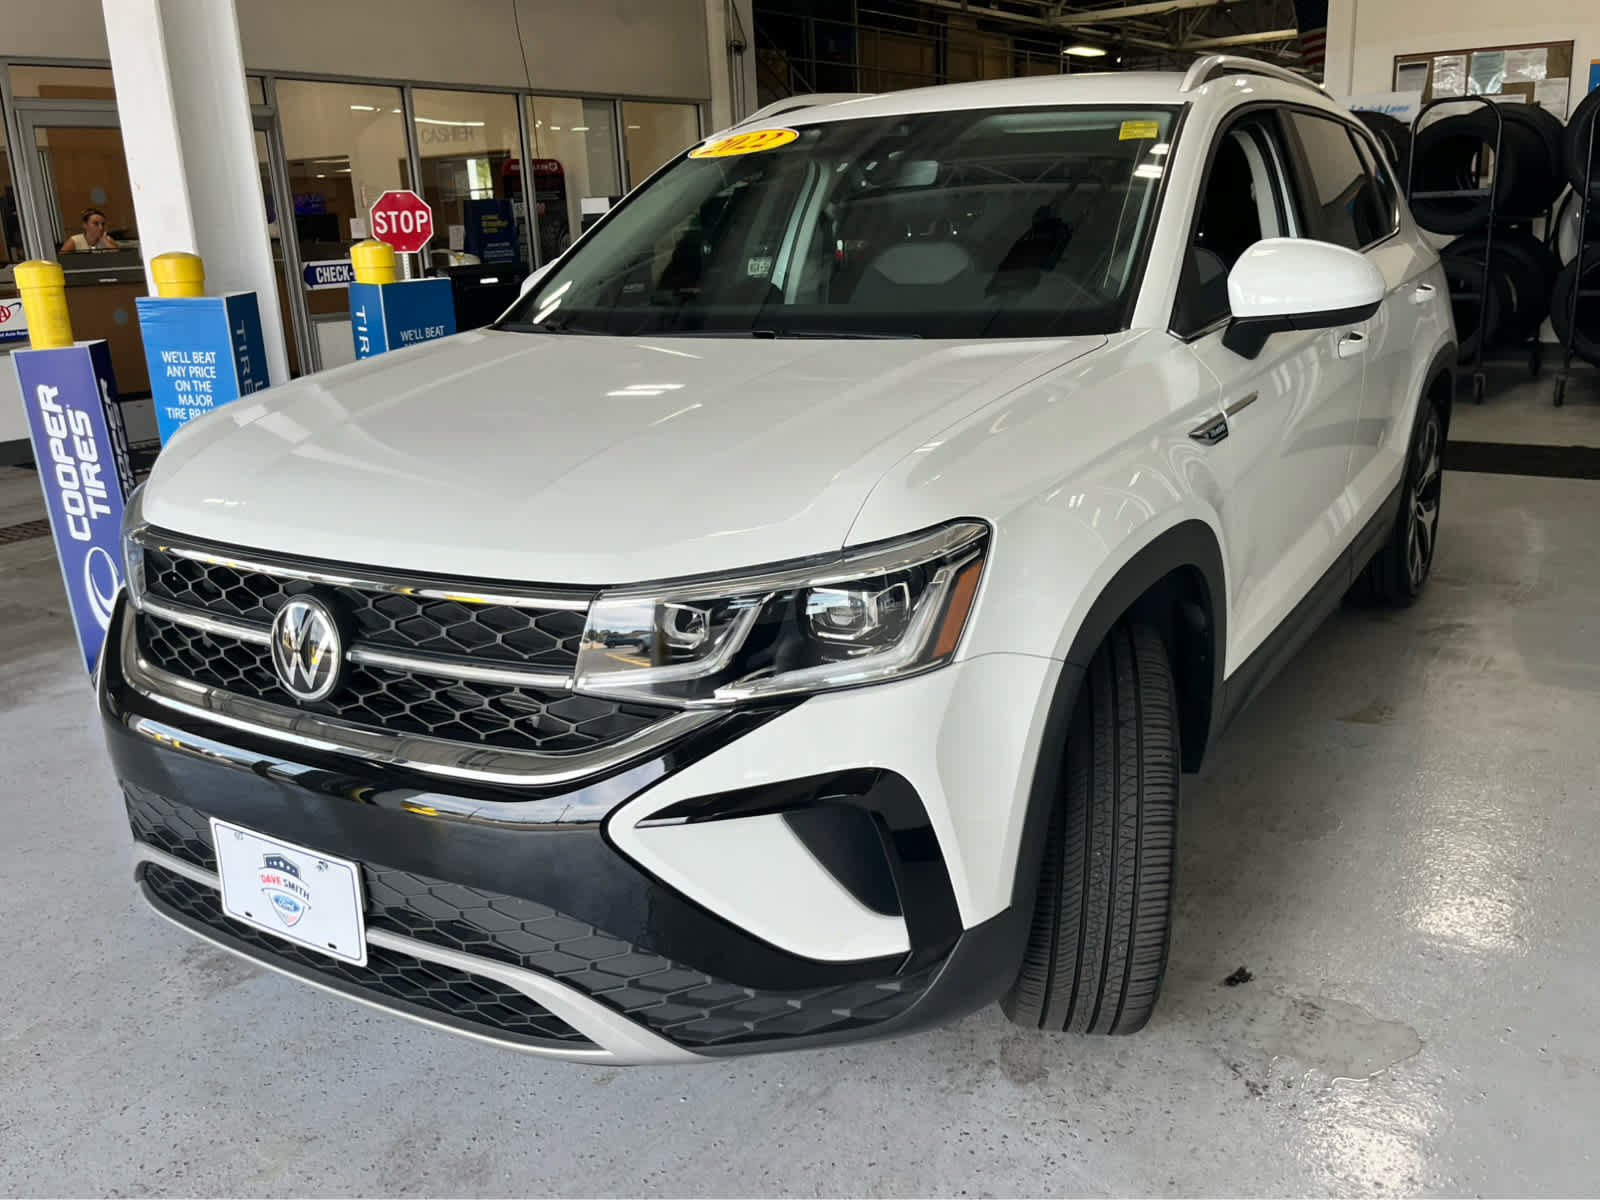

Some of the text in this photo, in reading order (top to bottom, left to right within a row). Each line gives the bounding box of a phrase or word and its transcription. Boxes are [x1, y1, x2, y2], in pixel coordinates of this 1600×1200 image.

[374, 209, 429, 235] STOP
[355, 305, 370, 360] TIR
[400, 325, 445, 342] WE'LL BEAT
[161, 351, 216, 364] WE'LL BEAT
[166, 366, 217, 378] ANY PRICE
[175, 380, 213, 392] ON THE
[178, 394, 214, 408] MAJOR
[165, 407, 188, 419] TIRE
[36, 384, 92, 542] COOPER
[72, 408, 112, 520] TIRES
[260, 873, 310, 901] DAVE SMITH
